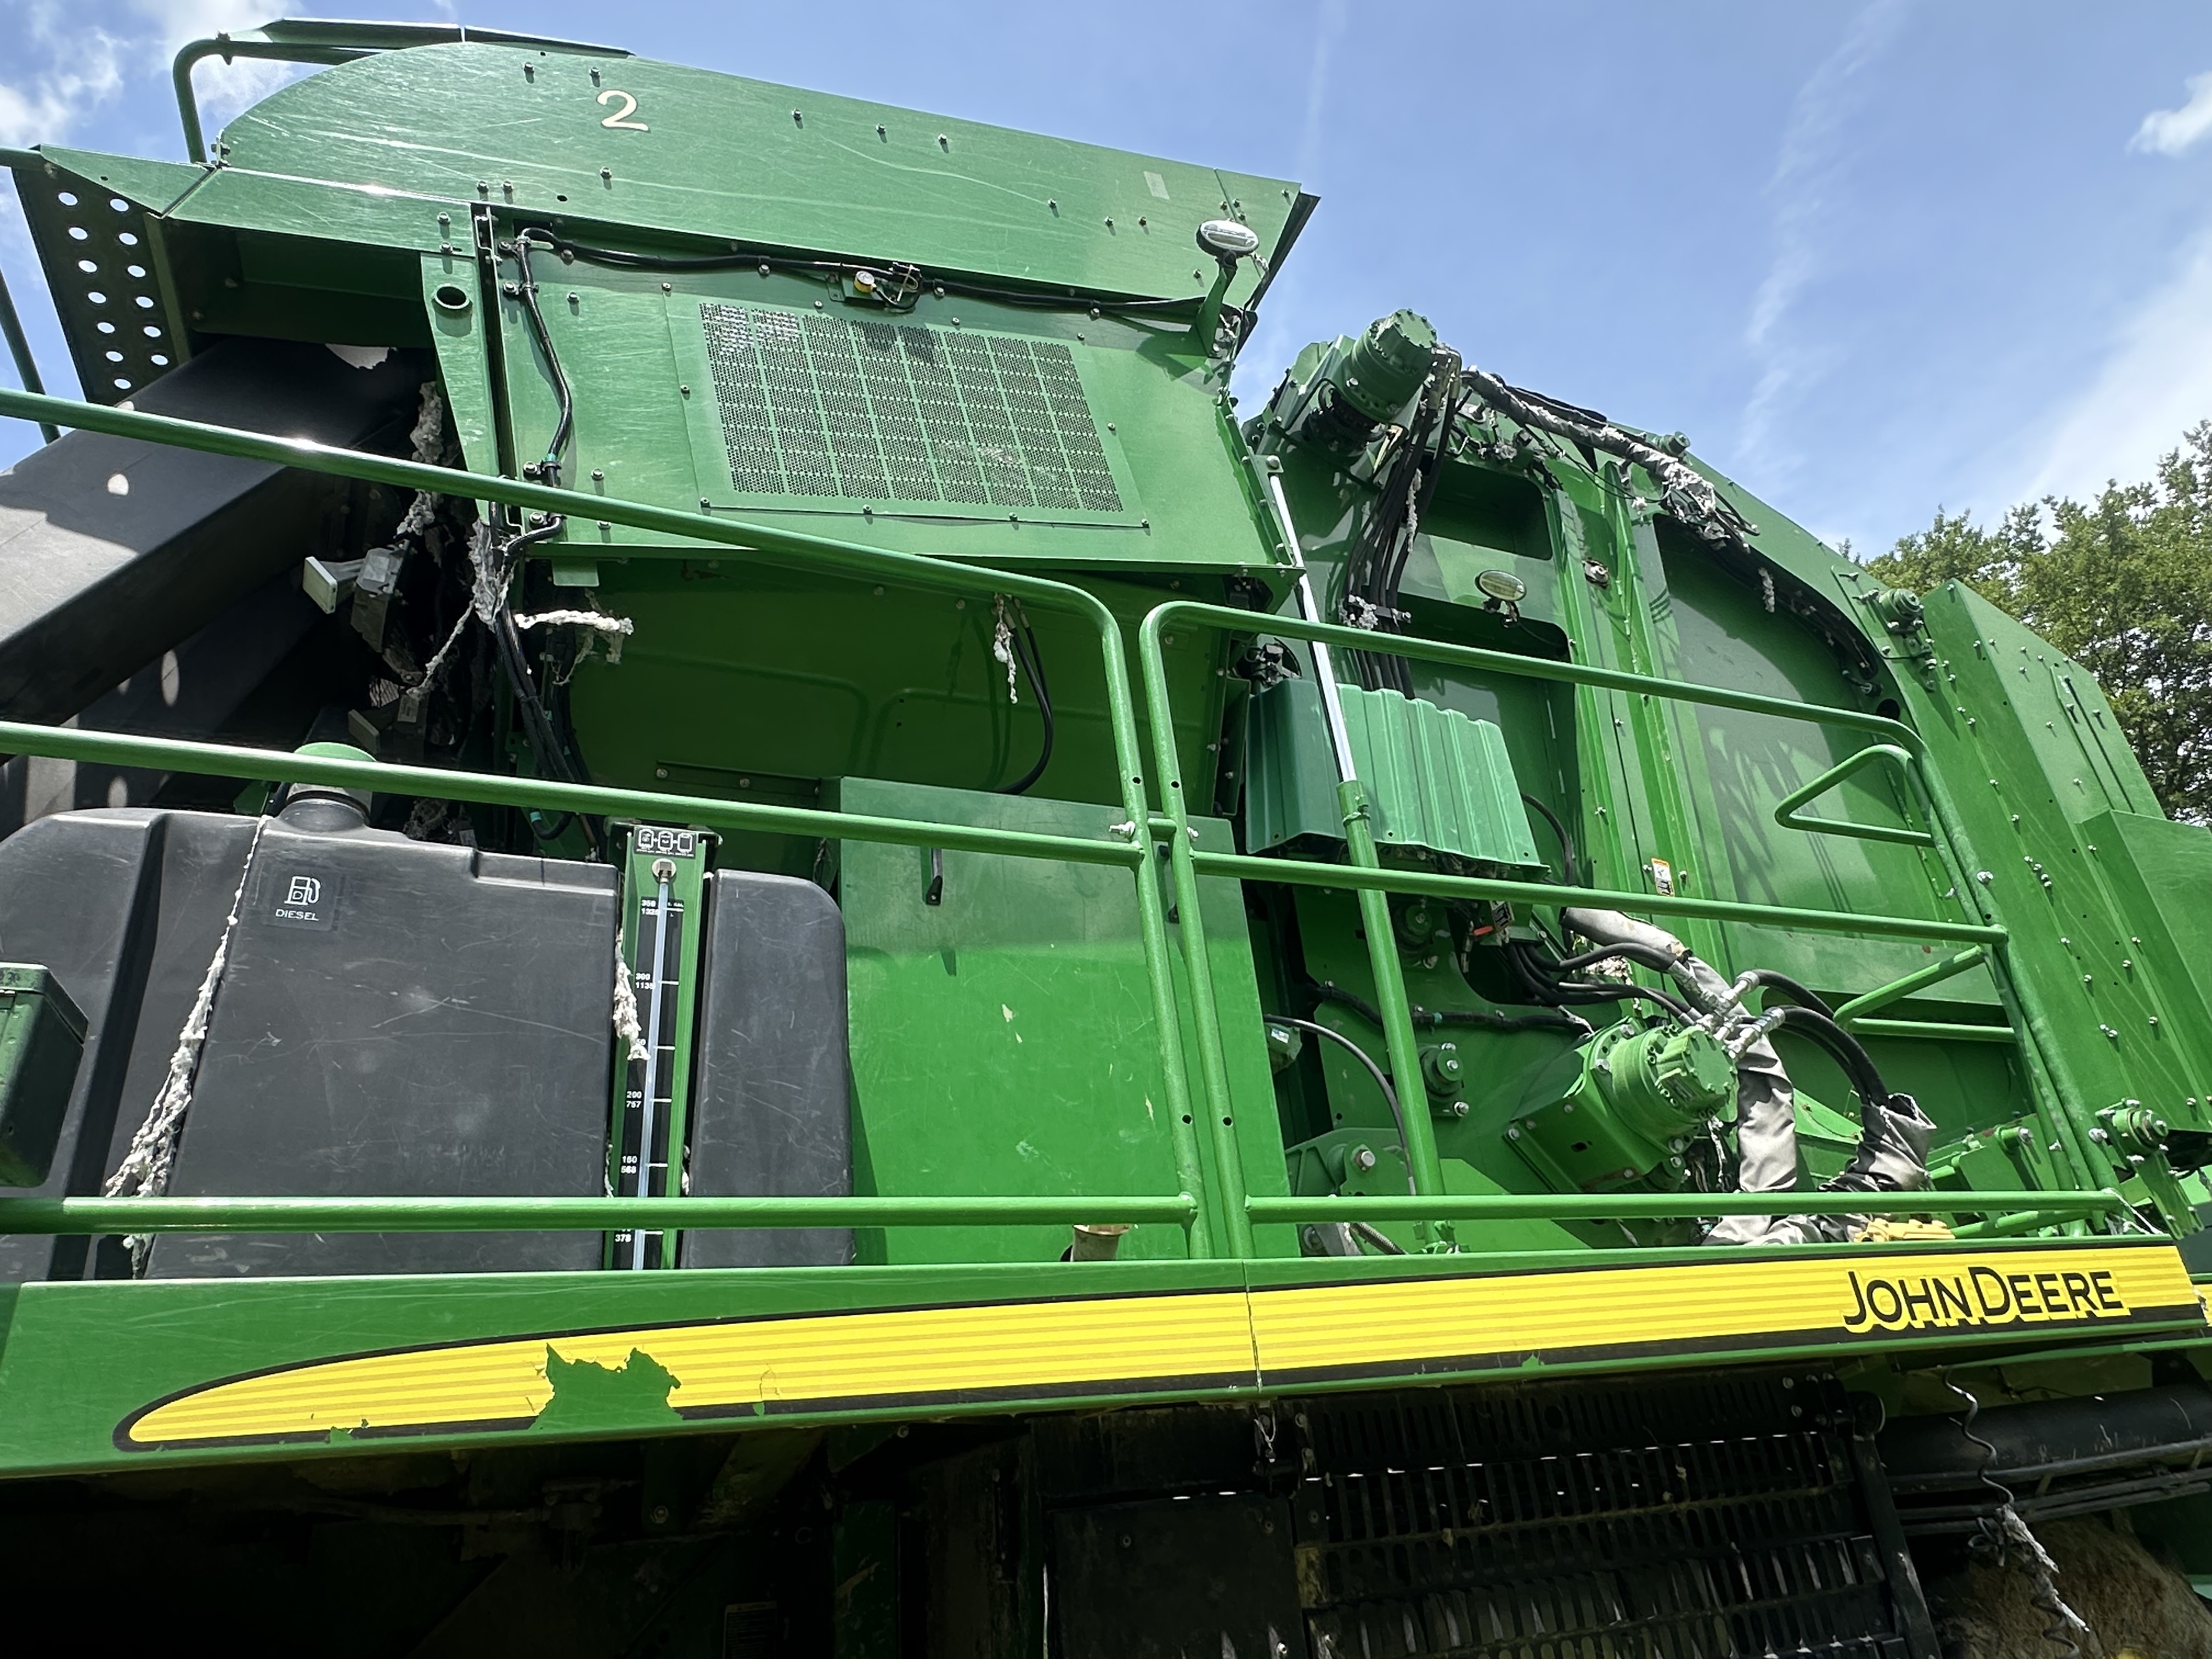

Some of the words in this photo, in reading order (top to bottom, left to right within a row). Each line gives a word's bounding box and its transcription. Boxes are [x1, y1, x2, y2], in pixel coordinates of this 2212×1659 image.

[597, 90, 648, 131] 2
[275, 909, 319, 921] DIESEL
[1842, 1271, 1973, 1325] JOHN
[1967, 1266, 2124, 1317] DEERE
